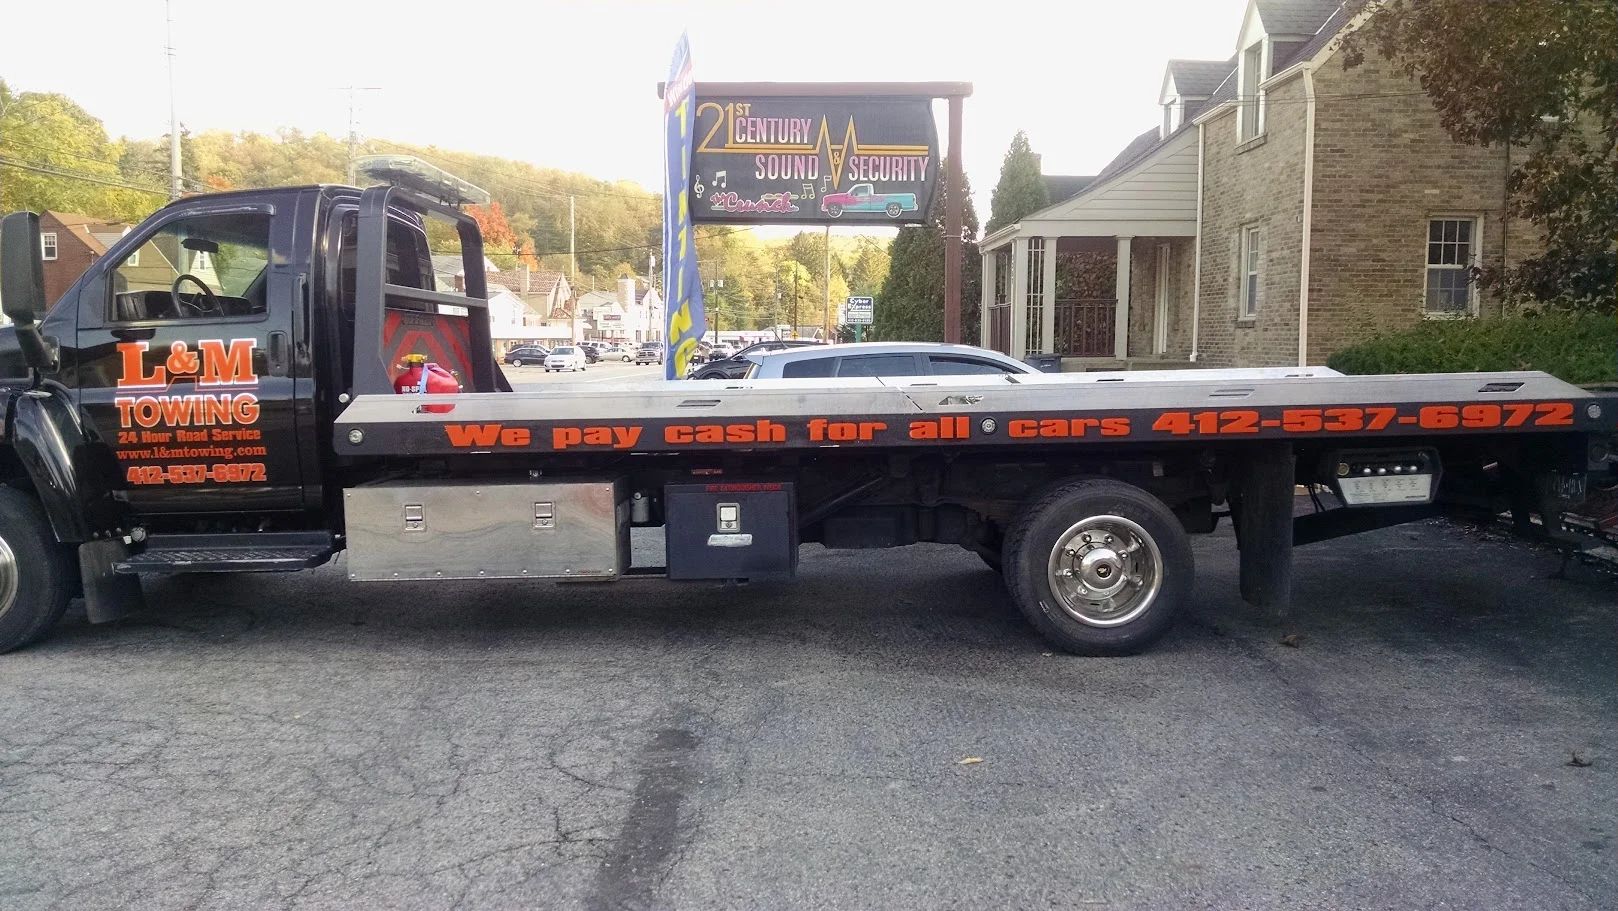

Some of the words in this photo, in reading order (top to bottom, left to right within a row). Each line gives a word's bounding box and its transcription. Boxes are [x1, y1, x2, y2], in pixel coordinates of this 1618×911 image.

[735, 117, 812, 144] CENTURY
[755, 154, 819, 180] SOUND
[834, 151, 841, 165] &
[848, 156, 929, 181] SECURITY
[116, 338, 258, 388] L&M
[115, 393, 260, 427] TOWING
[118, 431, 137, 444] 24
[142, 430, 171, 443] Hour
[176, 429, 208, 442] Road
[212, 428, 261, 441] Service
[445, 424, 531, 447] We
[553, 426, 642, 449] pay
[664, 420, 785, 443] cash
[807, 418, 887, 441] for
[909, 416, 970, 438] all
[1008, 416, 1130, 437] cars
[1152, 403, 1574, 435] 412-537-6972
[117, 446, 267, 460] www.l&mtowing.com
[127, 463, 267, 484] 412-537-6972
